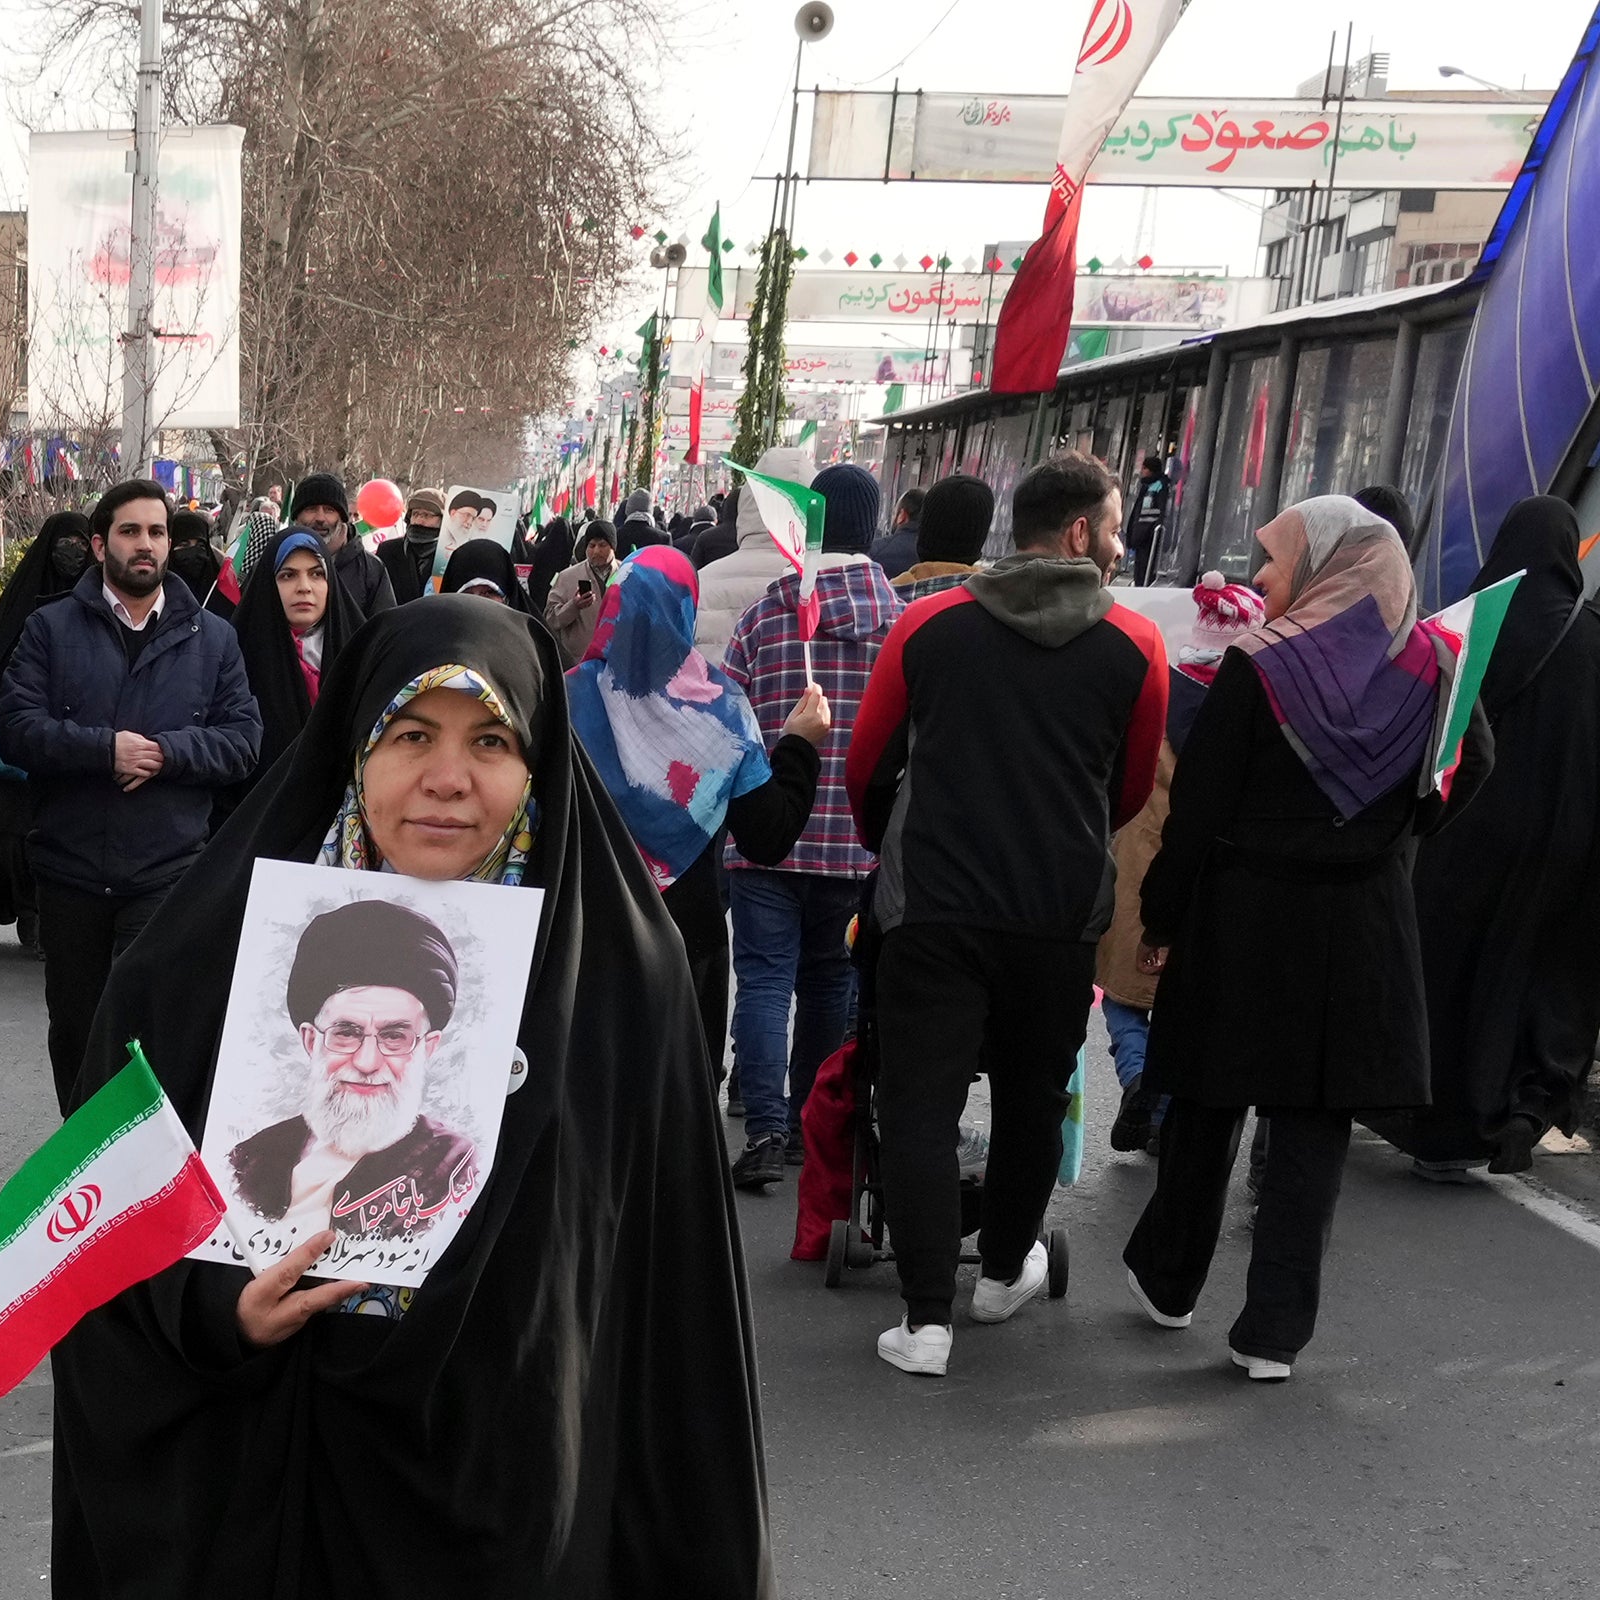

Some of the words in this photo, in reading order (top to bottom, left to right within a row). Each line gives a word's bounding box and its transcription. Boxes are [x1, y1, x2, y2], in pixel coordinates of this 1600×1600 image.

[1100, 113, 1193, 162] کردی
[1180, 109, 1330, 173] صعود
[413, 1145, 477, 1220] لبیک
